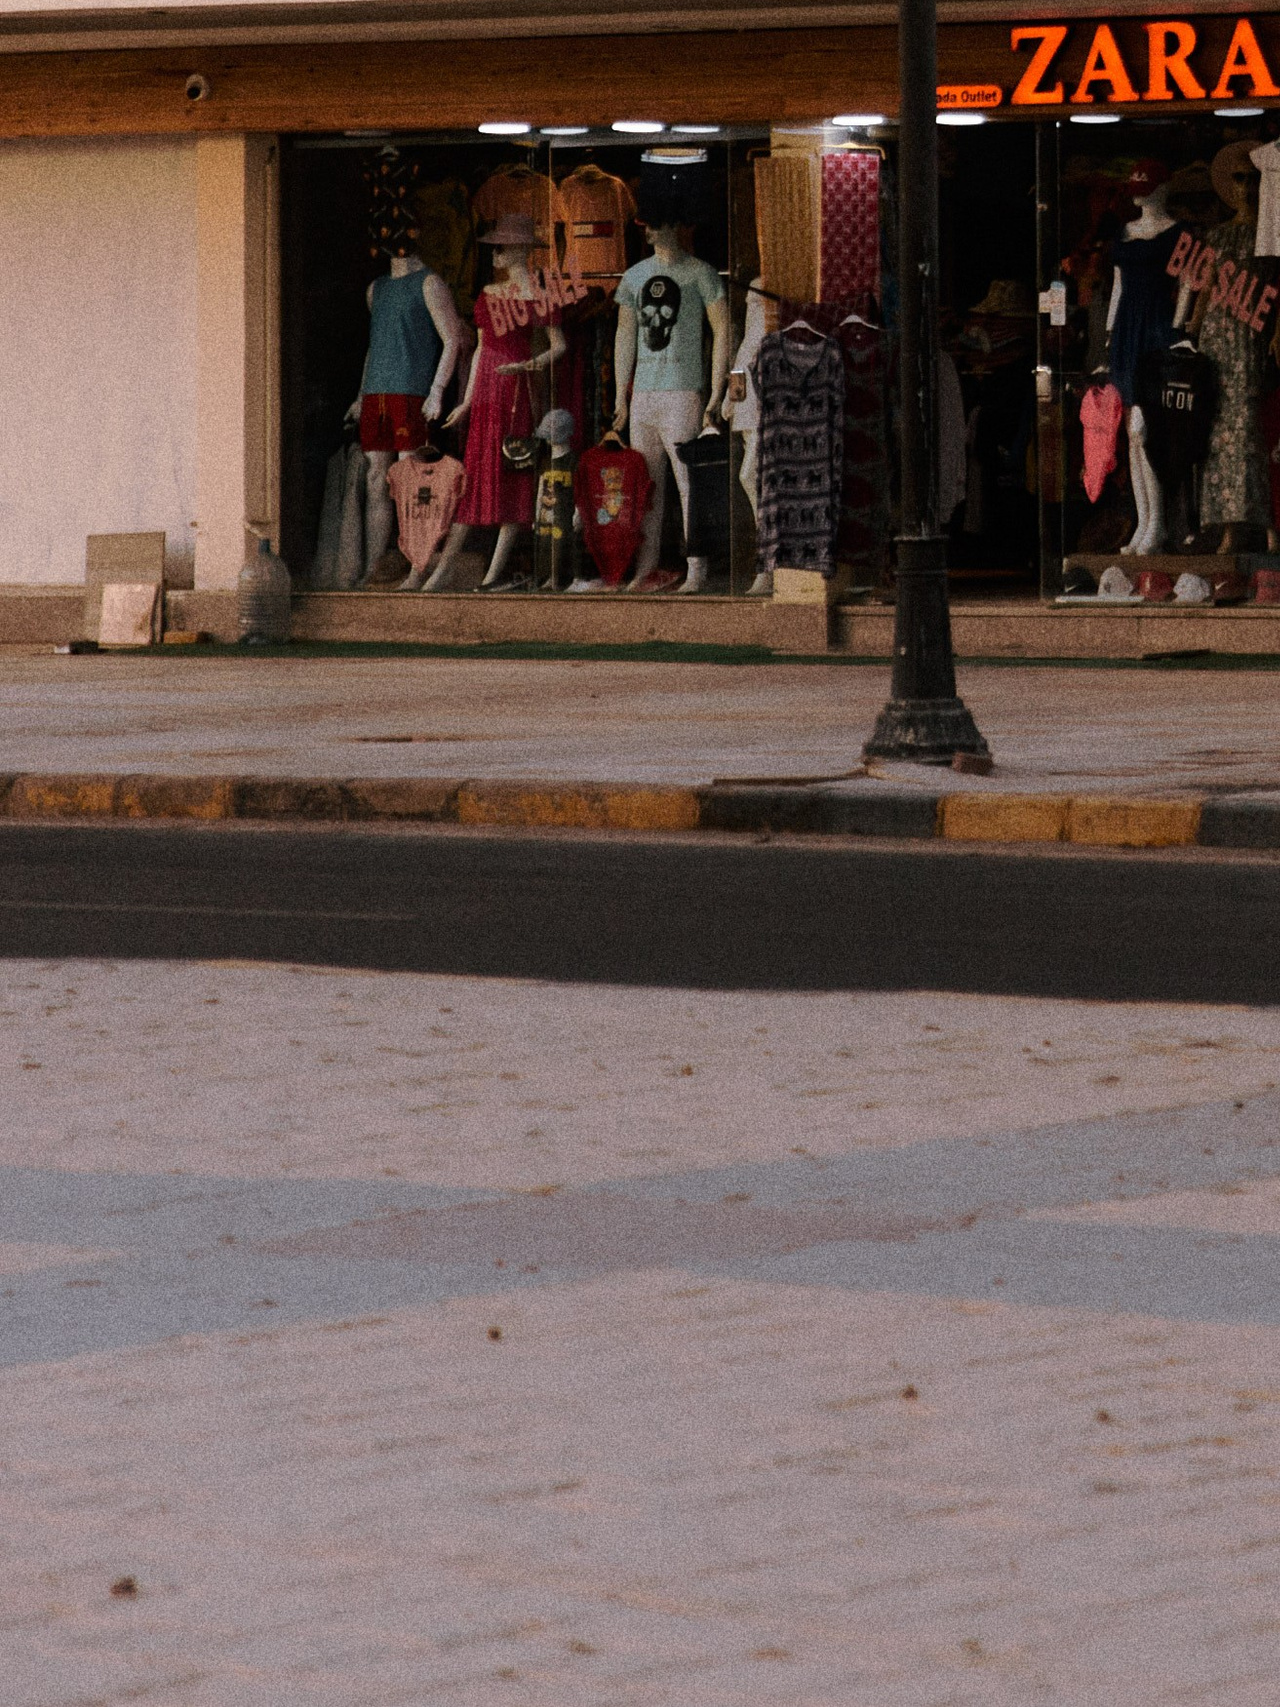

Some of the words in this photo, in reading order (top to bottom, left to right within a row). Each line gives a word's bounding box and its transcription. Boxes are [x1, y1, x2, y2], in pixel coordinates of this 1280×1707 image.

[961, 90, 998, 103] Outlet
[1010, 18, 1280, 105] ZARA
[484, 283, 529, 337] BIG
[528, 254, 588, 317] SALE
[1166, 232, 1215, 291] BIG
[1207, 260, 1278, 332] SALE
[1161, 390, 1195, 412] ICON
